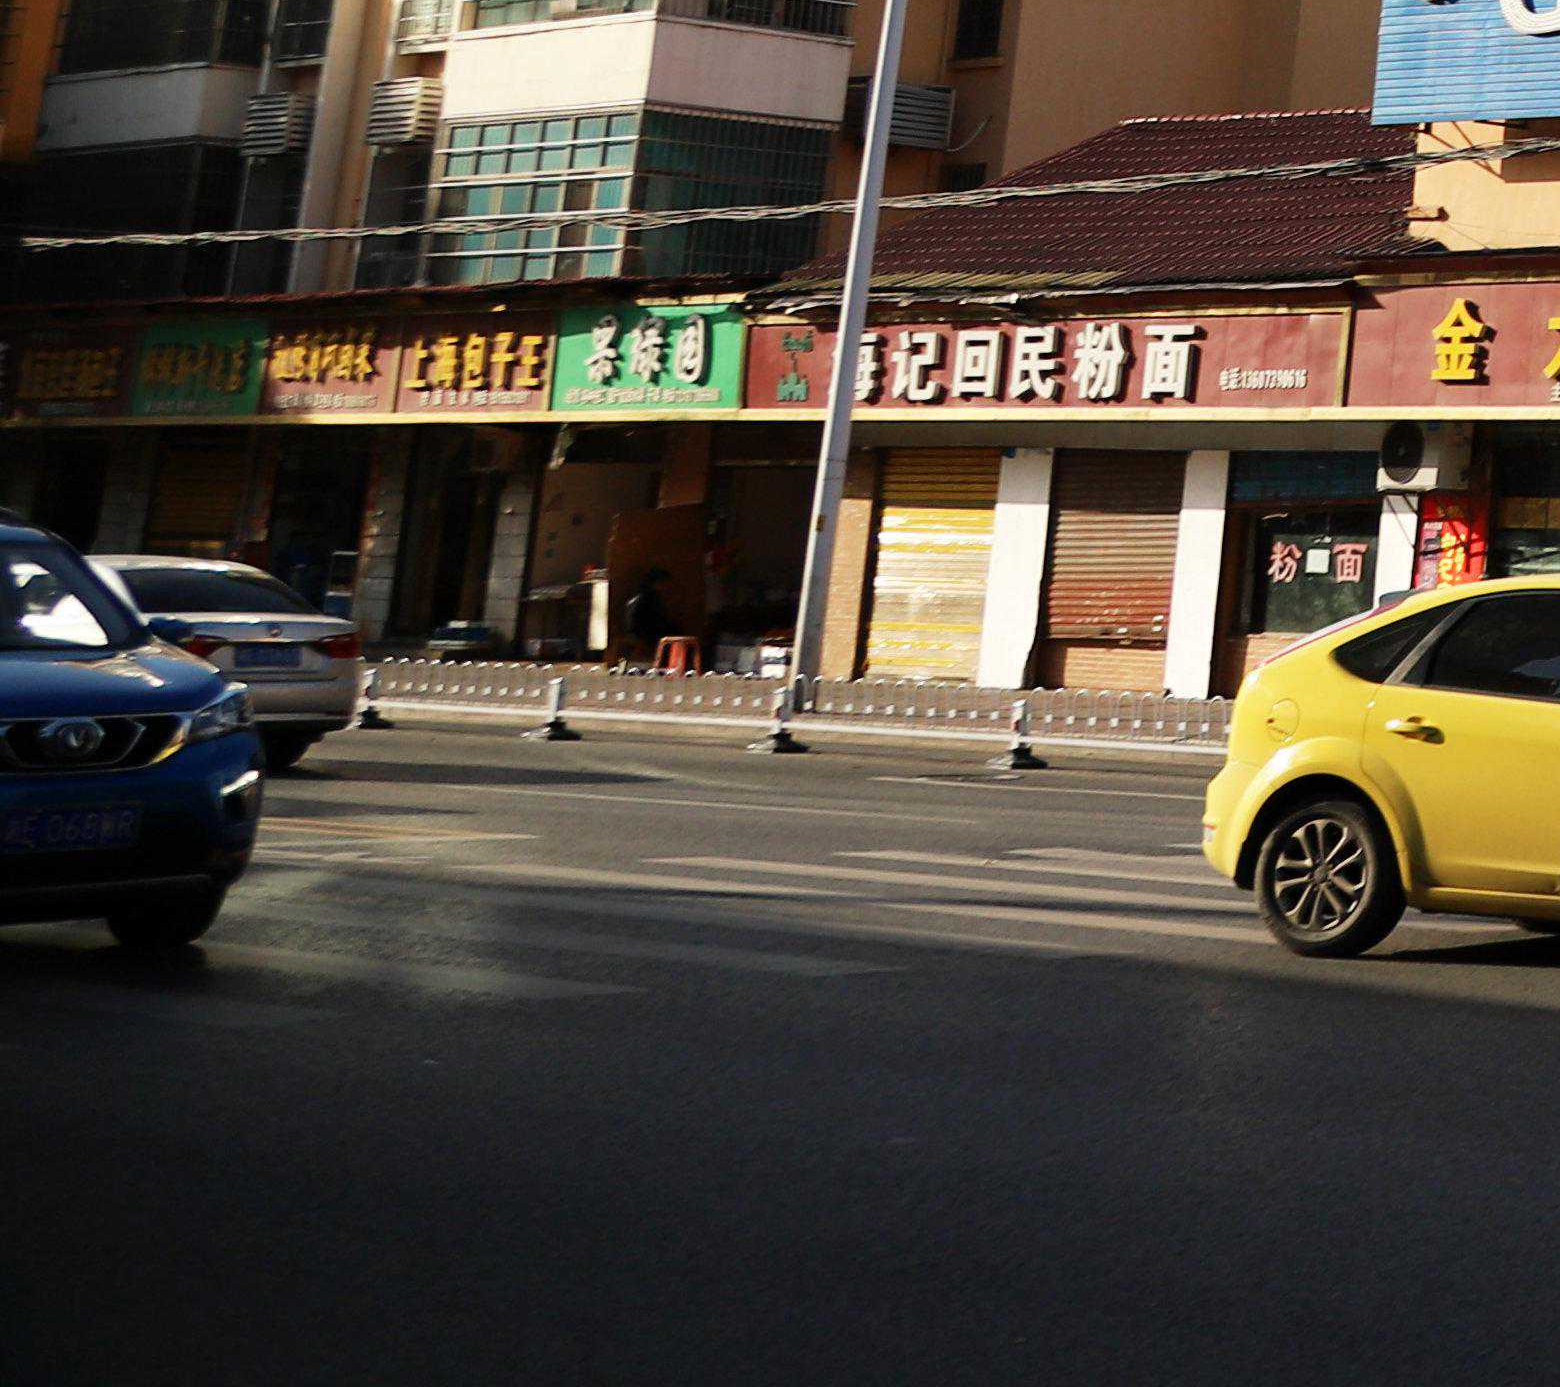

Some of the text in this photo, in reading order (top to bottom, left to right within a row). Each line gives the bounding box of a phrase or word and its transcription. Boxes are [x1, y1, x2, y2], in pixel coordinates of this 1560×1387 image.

[401, 331, 545, 390] 上海包子王
[1267, 540, 1369, 585] 粉 面
